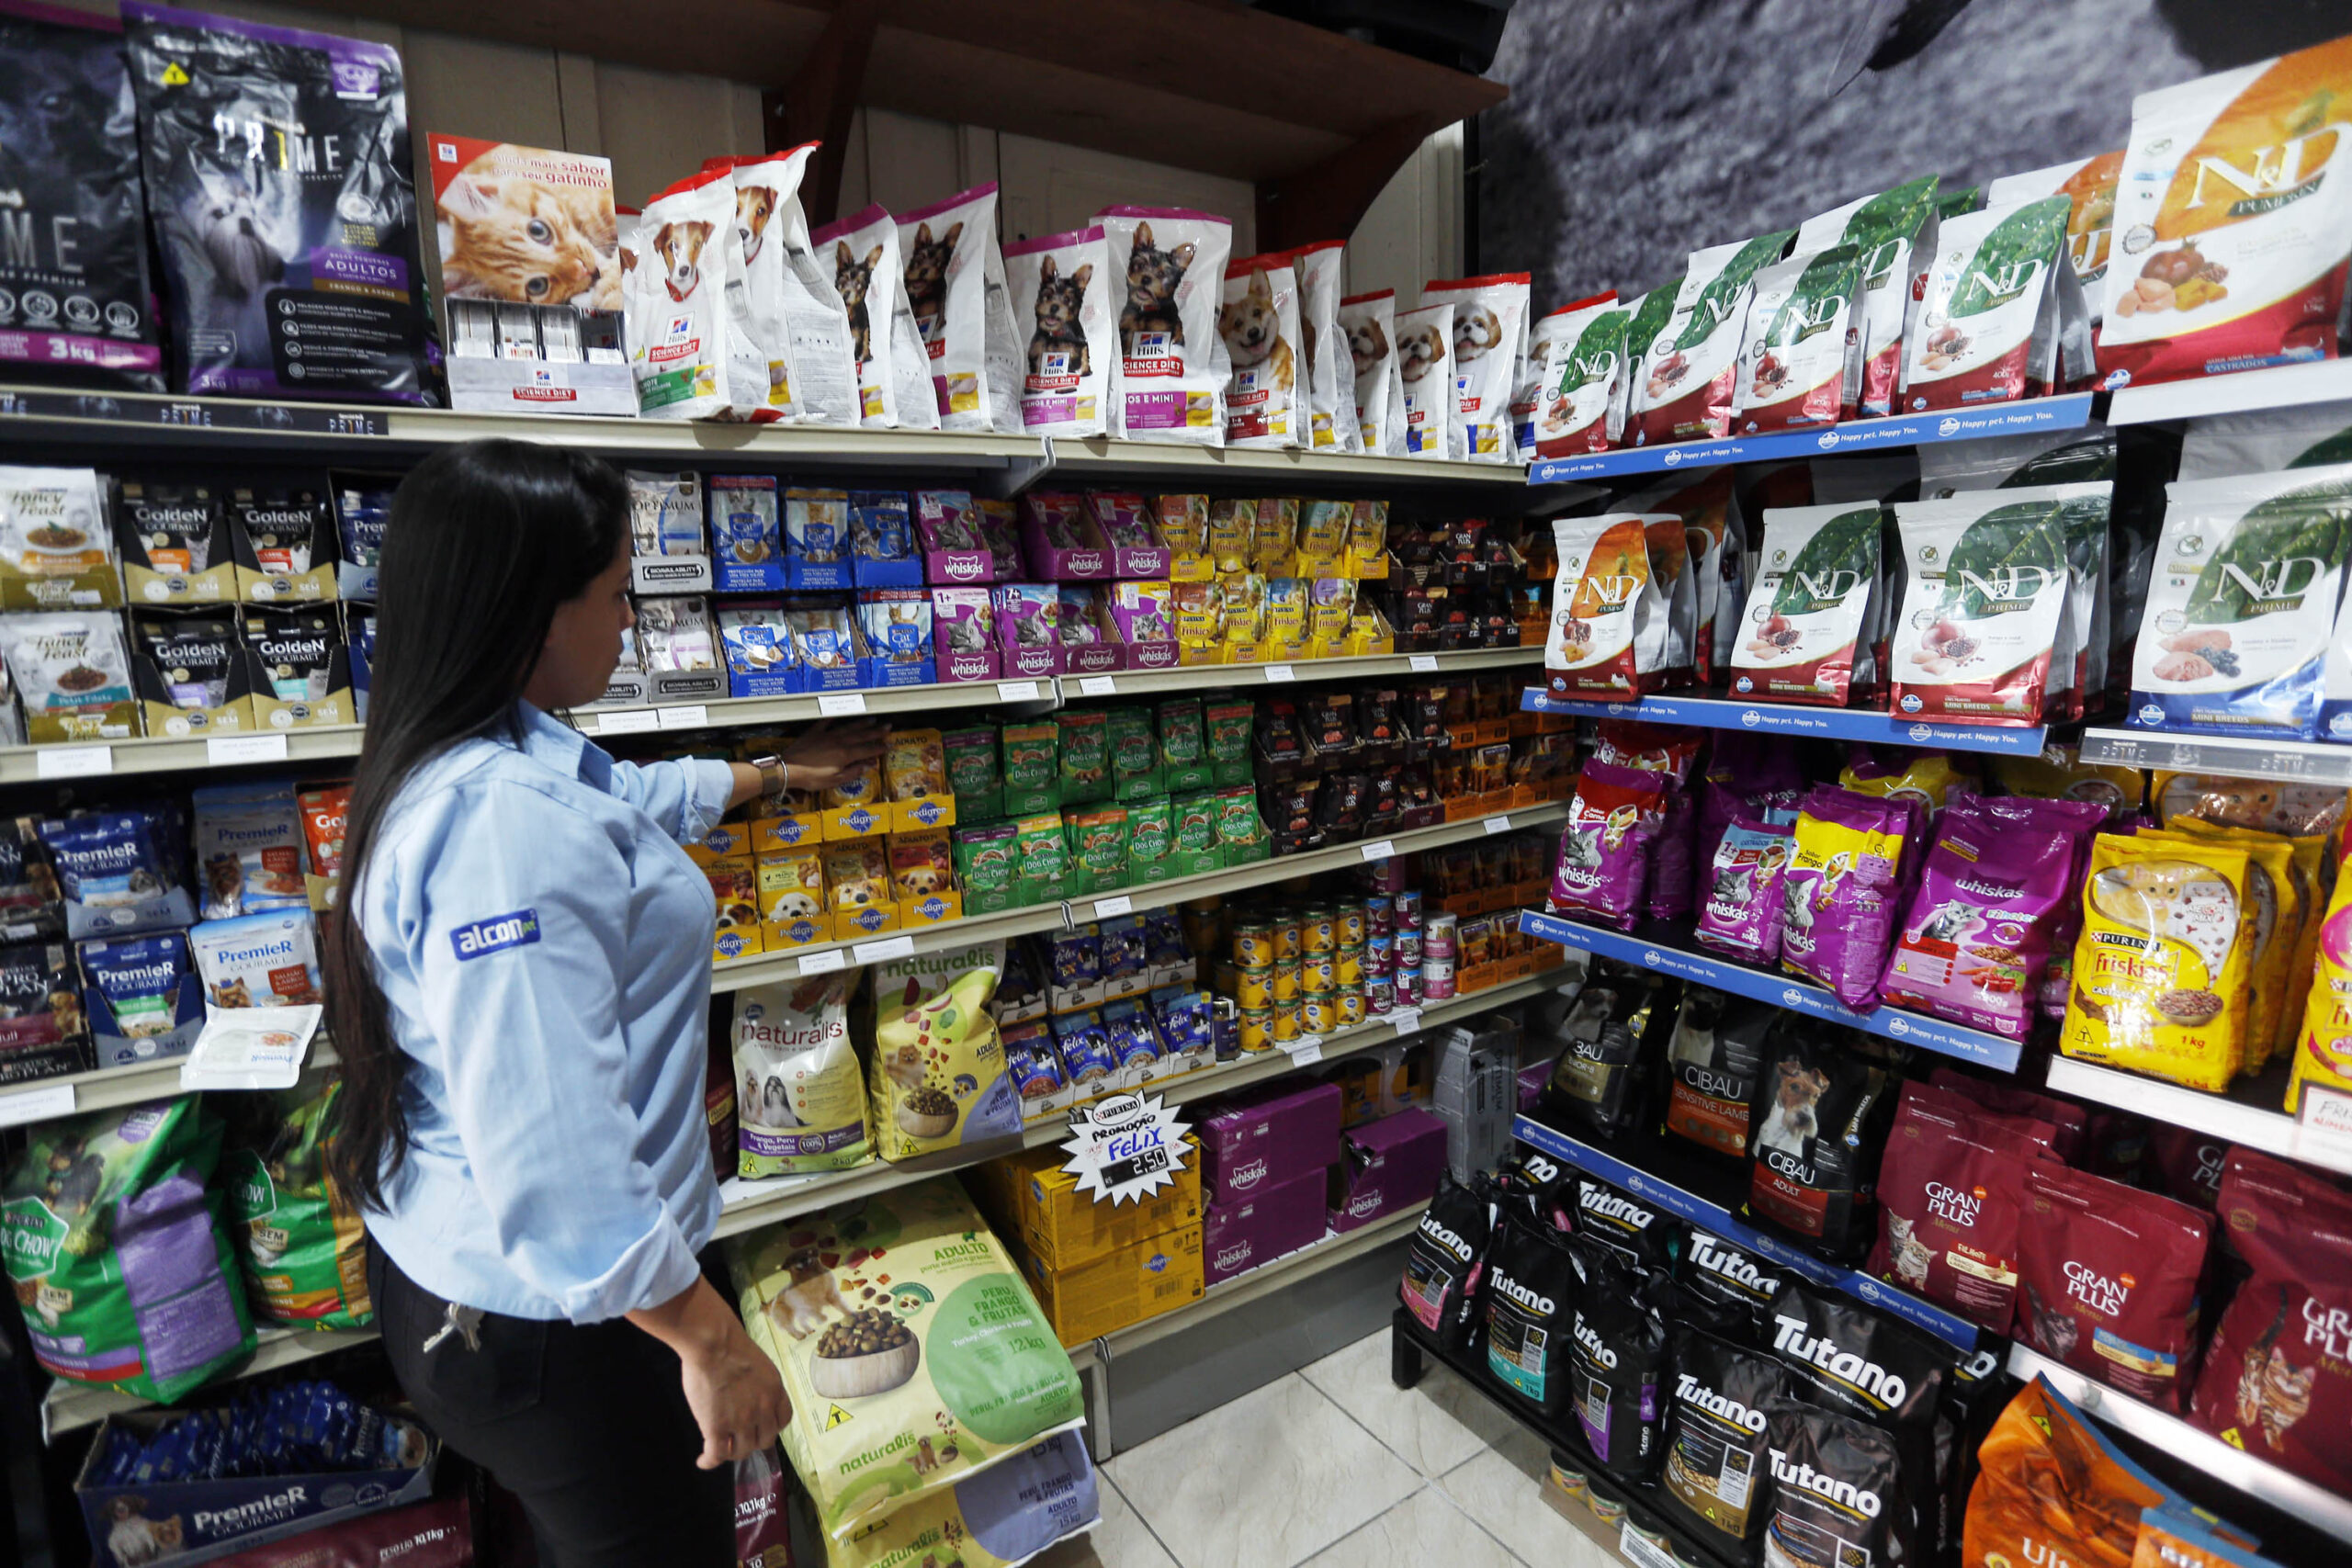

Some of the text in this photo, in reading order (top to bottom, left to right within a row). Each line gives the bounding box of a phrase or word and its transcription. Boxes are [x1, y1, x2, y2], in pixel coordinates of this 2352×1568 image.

[530, 158, 607, 178] mais sabor
[522, 172, 608, 191] seu gatinho
[324, 260, 398, 280] ADULTOS
[1124, 359, 1182, 371] CIENCE DIET
[1151, 398, 1174, 410] MINI
[1962, 412, 2054, 431] Happy pet. Happy You.
[1840, 426, 1918, 443] Happy pet. Happy You.
[944, 561, 984, 576] whiskas
[1068, 558, 1103, 571] whiskas
[1127, 557, 1163, 570] whiskas
[1953, 563, 2052, 604] N&D
[2209, 556, 2326, 603] N&D
[1583, 575, 1640, 605] N&D
[1986, 601, 2027, 614] PRIME
[156, 642, 228, 660] GoldeN
[260, 639, 327, 655] GoldeN
[1139, 649, 1174, 663] whiskas
[950, 662, 990, 676] whiskas
[1017, 655, 1056, 670] whiskas
[1080, 653, 1116, 667] whiskas
[1761, 715, 1828, 728] Happy pet. Happy You.
[1934, 729, 2019, 745] Happy pet. Happy You.
[315, 814, 348, 829] Gol
[838, 813, 881, 829] Pedigree
[909, 805, 949, 819] Pedigree
[1583, 808, 1607, 823] Carne
[701, 833, 741, 848] edigree
[766, 823, 810, 840] Pedigree
[1721, 840, 1740, 854] 1+
[1026, 856, 1062, 870] DOG CHOW
[1797, 852, 1825, 869] Frango
[1558, 864, 1602, 889] whiskas
[1955, 877, 2026, 899] whiskas
[914, 901, 954, 916] Pedigree
[1706, 901, 1750, 922] whiskas
[1985, 909, 2039, 923] Filhotes
[850, 911, 892, 927] Pedigree
[458, 918, 525, 953] alcon
[779, 923, 823, 939] Pedigree
[713, 936, 752, 952] edigree
[2103, 933, 2162, 953] PURINA
[886, 948, 996, 978] naturalis
[2096, 952, 2170, 985] friskies
[109, 977, 170, 993] GOURMET
[1168, 1013, 1190, 1032] felix
[740, 1020, 844, 1047] naturalis
[1909, 1025, 1992, 1055] Happy pet. Happy You.
[1061, 1035, 1086, 1055] felix
[1686, 1066, 1743, 1100] CIBAU
[1103, 1100, 1139, 1120] PURINA
[1676, 1087, 1717, 1113] SENSITIVE
[1091, 1112, 1157, 1143] PROMOÇÃO
[776, 1136, 796, 1145] Peru
[1229, 1165, 1269, 1188] whiskas
[1769, 1152, 1817, 1186] CIBAU
[1773, 1178, 1802, 1198] ADULT
[1925, 1181, 1983, 1215] GRAN
[1350, 1195, 1385, 1217] whiskas
[1579, 1180, 1657, 1230] Tutano
[1927, 1198, 1976, 1228] PLUS
[13, 1229, 55, 1259] CHOW
[260, 1229, 286, 1242] SEM
[1419, 1211, 1474, 1263] utano
[934, 1242, 989, 1261] ADULTO
[1214, 1245, 1254, 1270] whiskas
[1689, 1232, 1781, 1296] Tutan
[1489, 1265, 1556, 1314] Tutano
[2063, 1260, 2129, 1304] GRAN
[981, 1286, 1017, 1301] PERU,
[2066, 1280, 2120, 1318] PLUS
[974, 1294, 1022, 1314] FRANGO
[1880, 1292, 1954, 1334] Happy pet. Happy You.
[968, 1304, 1028, 1327] & FRUTAS
[1773, 1314, 1907, 1409] Tutano
[1040, 1385, 1071, 1404] ADULTO
[1675, 1372, 1768, 1434] Tutano
[840, 1432, 918, 1476] naturalis
[1769, 1448, 1883, 1519] Tutano
[1048, 1496, 1078, 1515] ADULTO
